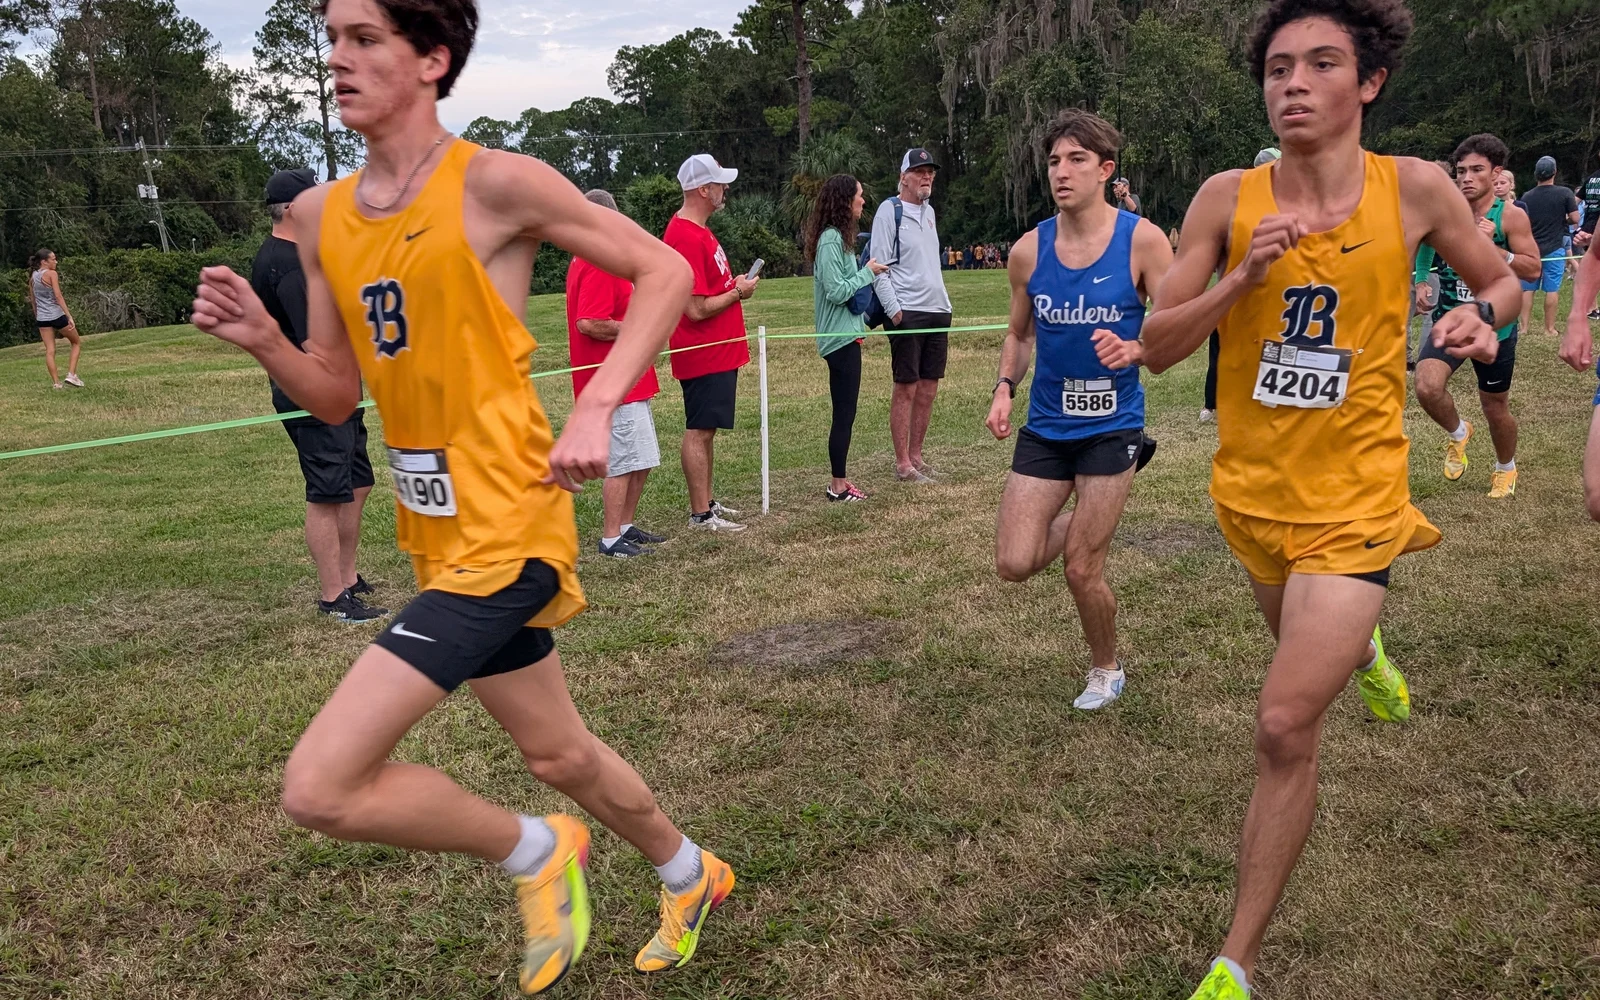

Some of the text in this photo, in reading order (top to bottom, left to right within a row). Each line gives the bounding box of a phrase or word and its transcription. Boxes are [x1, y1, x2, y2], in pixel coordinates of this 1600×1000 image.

[361, 276, 411, 361] B
[1034, 294, 1124, 324] Raiders
[1278, 280, 1339, 348] B
[1065, 393, 1113, 411] 5586
[1260, 367, 1340, 402] 4204
